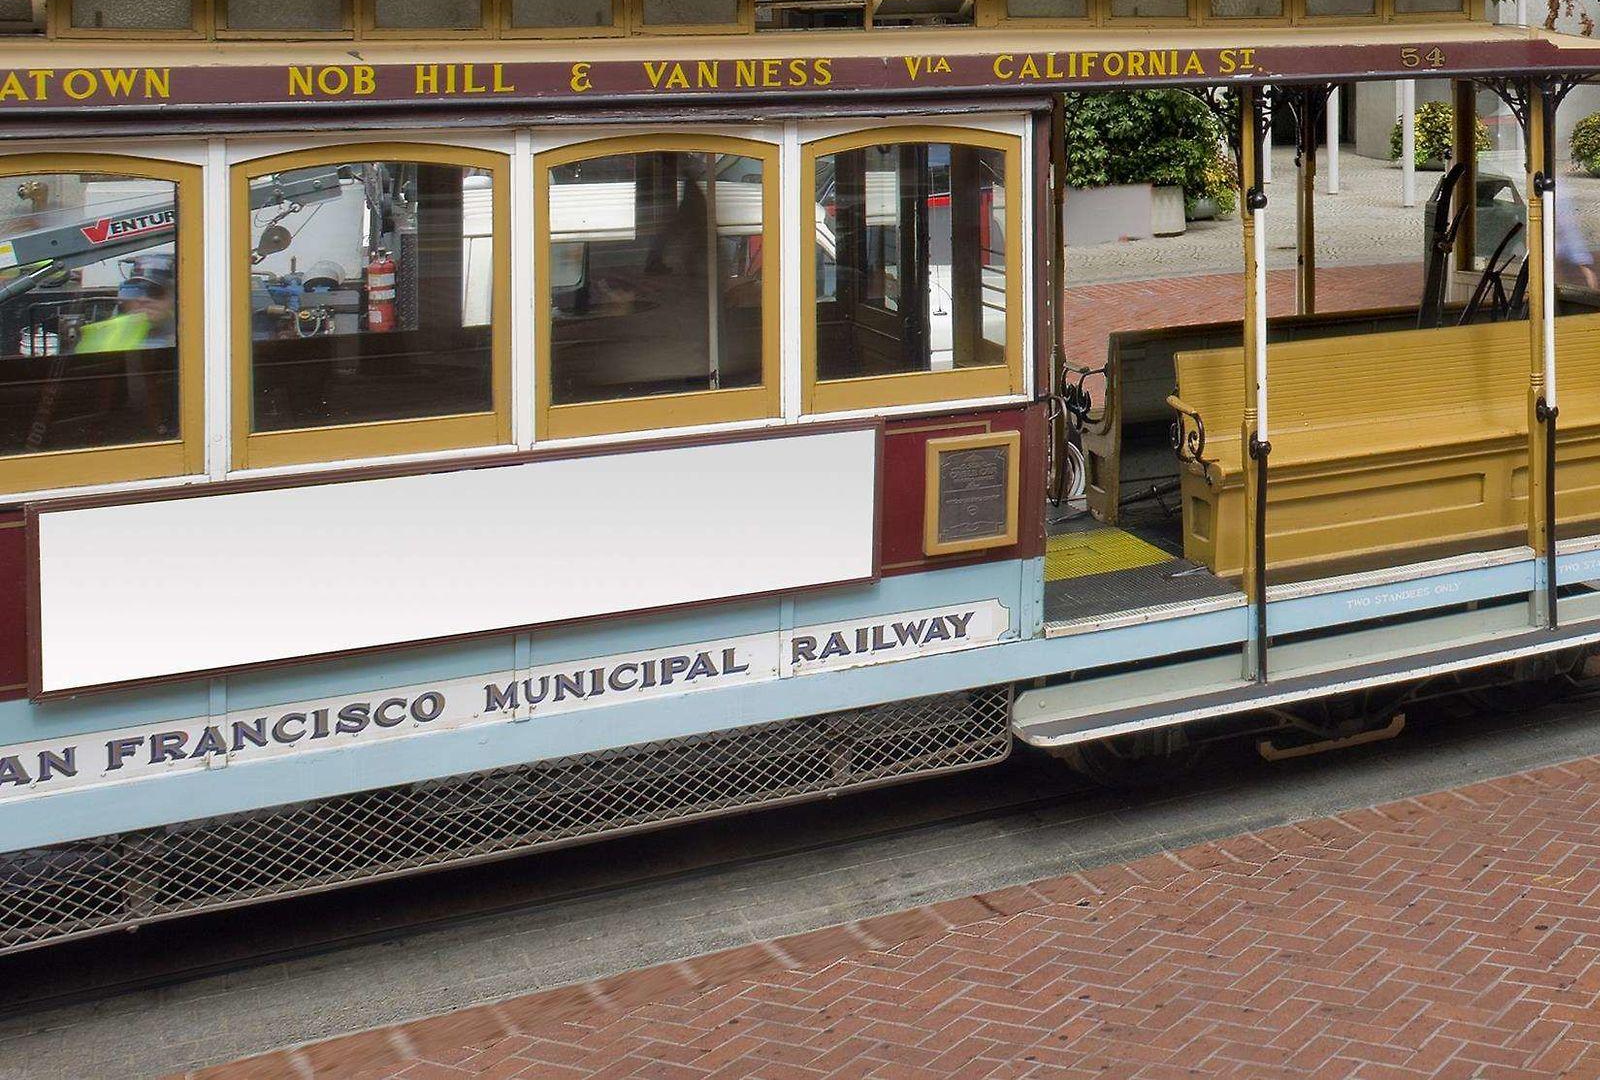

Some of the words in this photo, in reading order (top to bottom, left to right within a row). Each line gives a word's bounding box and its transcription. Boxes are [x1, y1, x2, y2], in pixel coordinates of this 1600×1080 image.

[1400, 45, 1446, 68] 54
[0, 68, 171, 101] ATOWN
[288, 65, 376, 96] NOB
[414, 63, 515, 94] HILL
[570, 62, 591, 93] &
[642, 61, 719, 89] VAN
[735, 58, 832, 87] NESS
[992, 50, 1205, 80] CALIFORNIA
[1434, 579, 1464, 595] ONLY
[0, 746, 79, 787] AN
[103, 690, 447, 771] FRANCISCO
[483, 647, 751, 713] MUNICIPAL
[790, 611, 977, 666] RAILWAY
